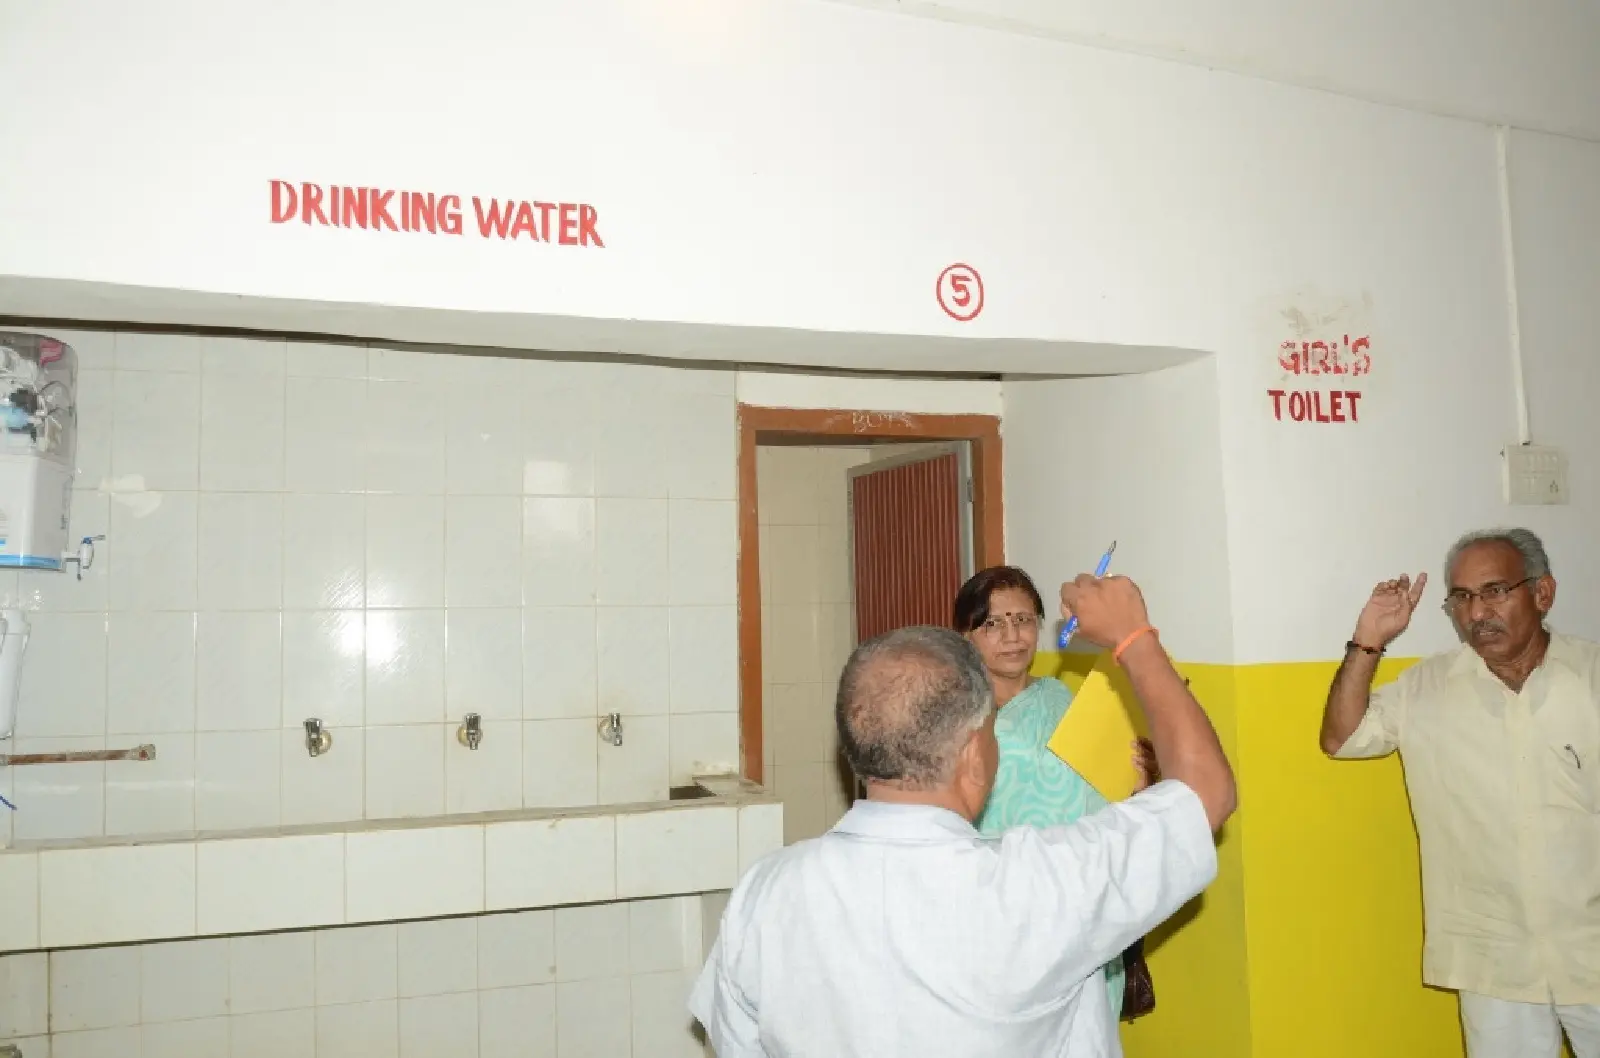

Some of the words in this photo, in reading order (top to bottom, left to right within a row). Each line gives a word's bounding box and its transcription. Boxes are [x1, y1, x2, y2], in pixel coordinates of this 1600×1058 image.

[268, 179, 463, 235] DRINKING
[472, 196, 604, 247] WATER
[951, 274, 972, 306] 5
[1278, 334, 1371, 376] GIRL'S
[1267, 390, 1361, 423] TOILET
